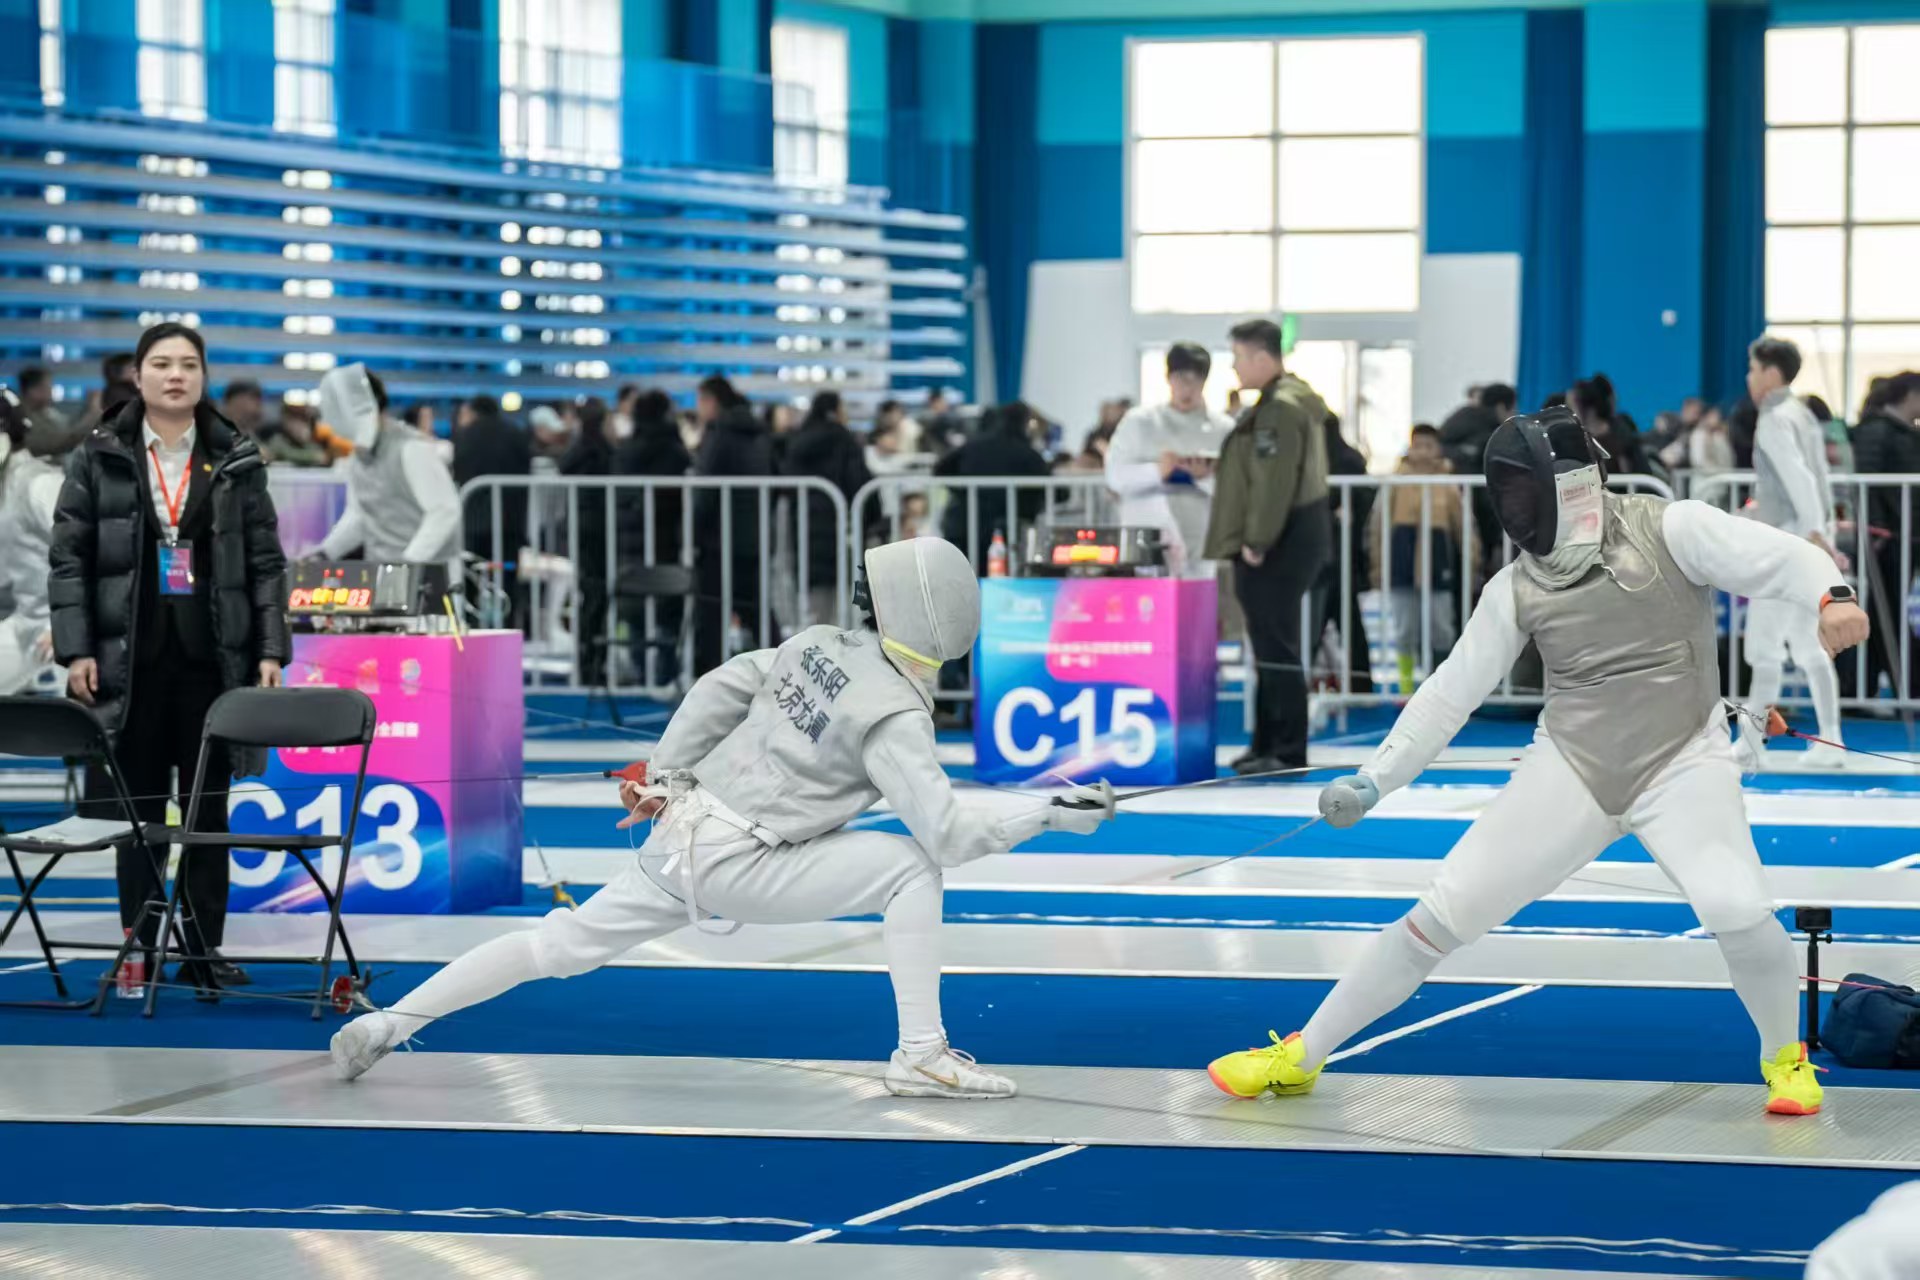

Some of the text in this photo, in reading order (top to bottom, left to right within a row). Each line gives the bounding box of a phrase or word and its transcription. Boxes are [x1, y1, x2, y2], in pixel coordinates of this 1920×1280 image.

[773, 671, 831, 744] 北京龙潭
[993, 686, 1157, 769] C15
[227, 782, 423, 891] C13
